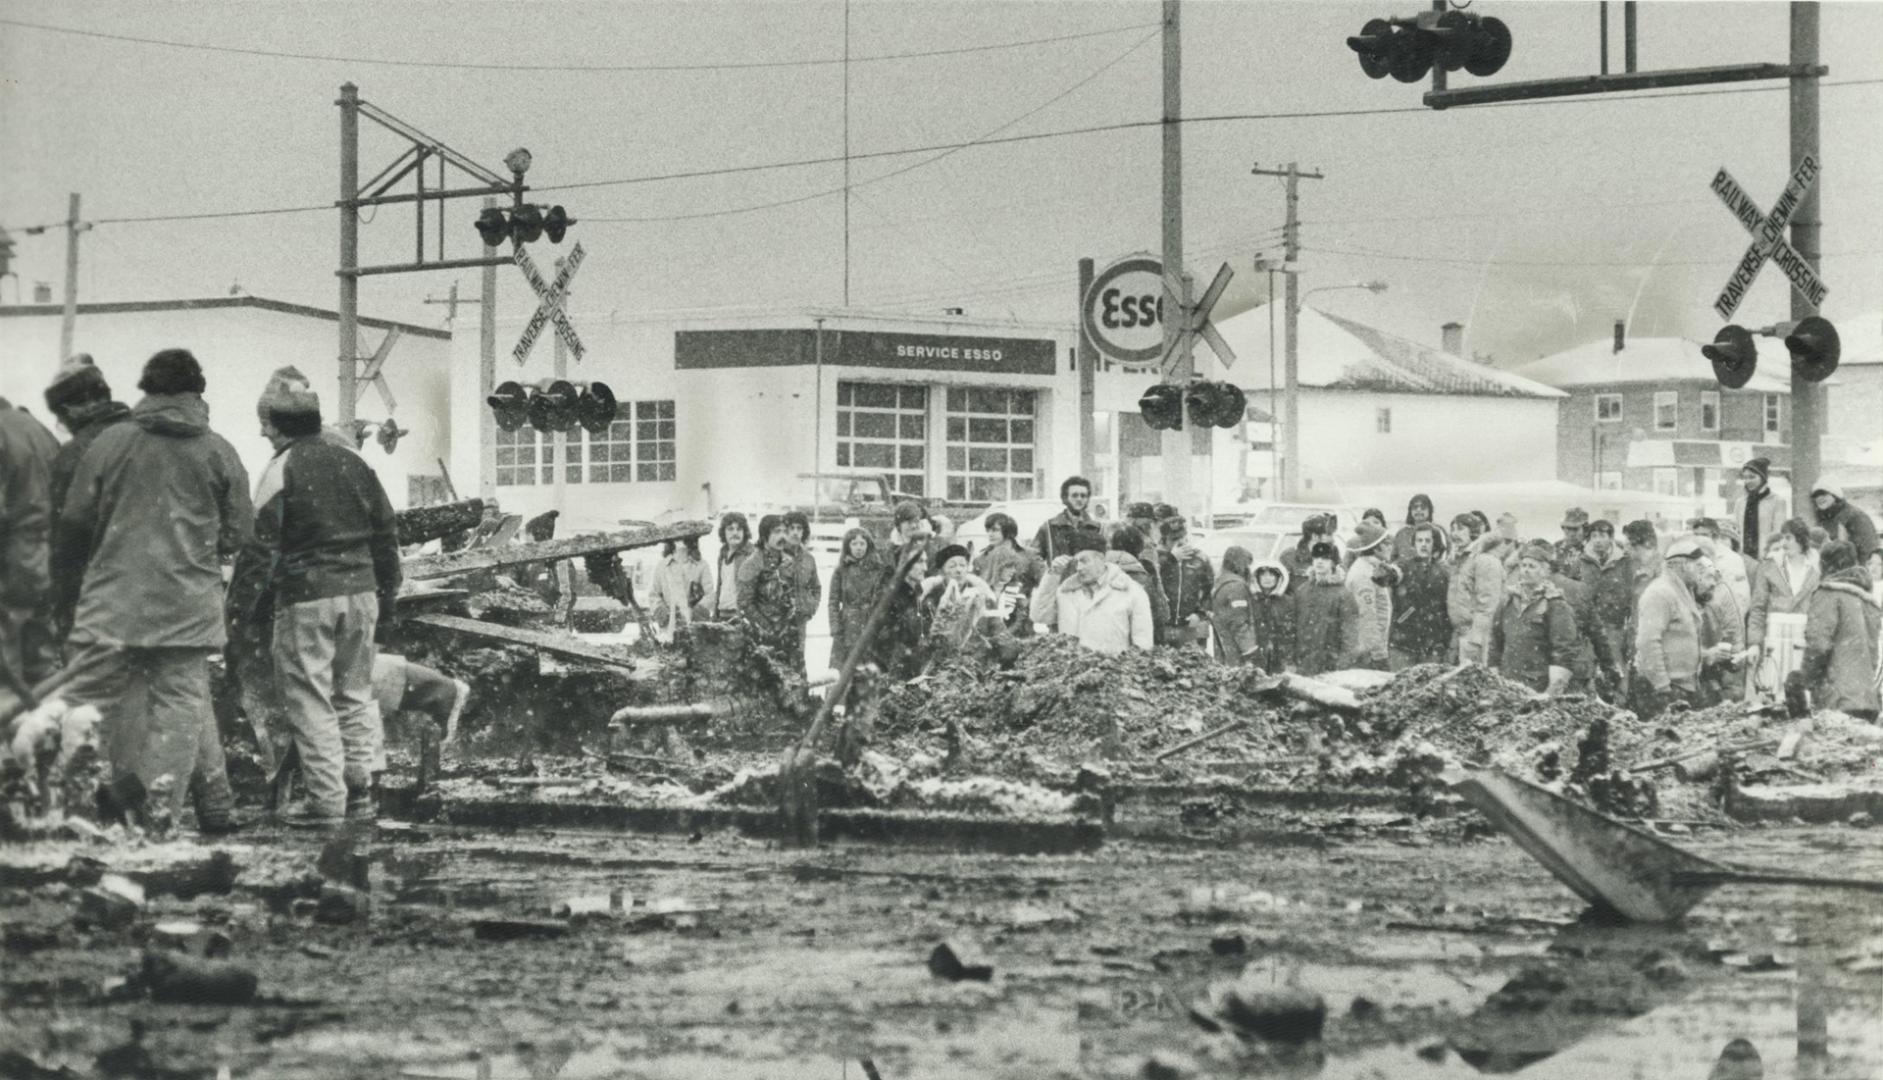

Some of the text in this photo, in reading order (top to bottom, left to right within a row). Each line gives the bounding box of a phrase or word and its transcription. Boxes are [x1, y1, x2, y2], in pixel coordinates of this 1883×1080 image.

[1711, 170, 1827, 307] RAILWAY CROSSING
[1714, 156, 1818, 317] TRAVERSE CHEMIN FER
[513, 305, 548, 361] TRAVERSE
[546, 268, 569, 307] CHEMIN
[515, 247, 585, 361] RAILWAY CROSSING
[897, 345, 1002, 361] SERVICE ESSO
